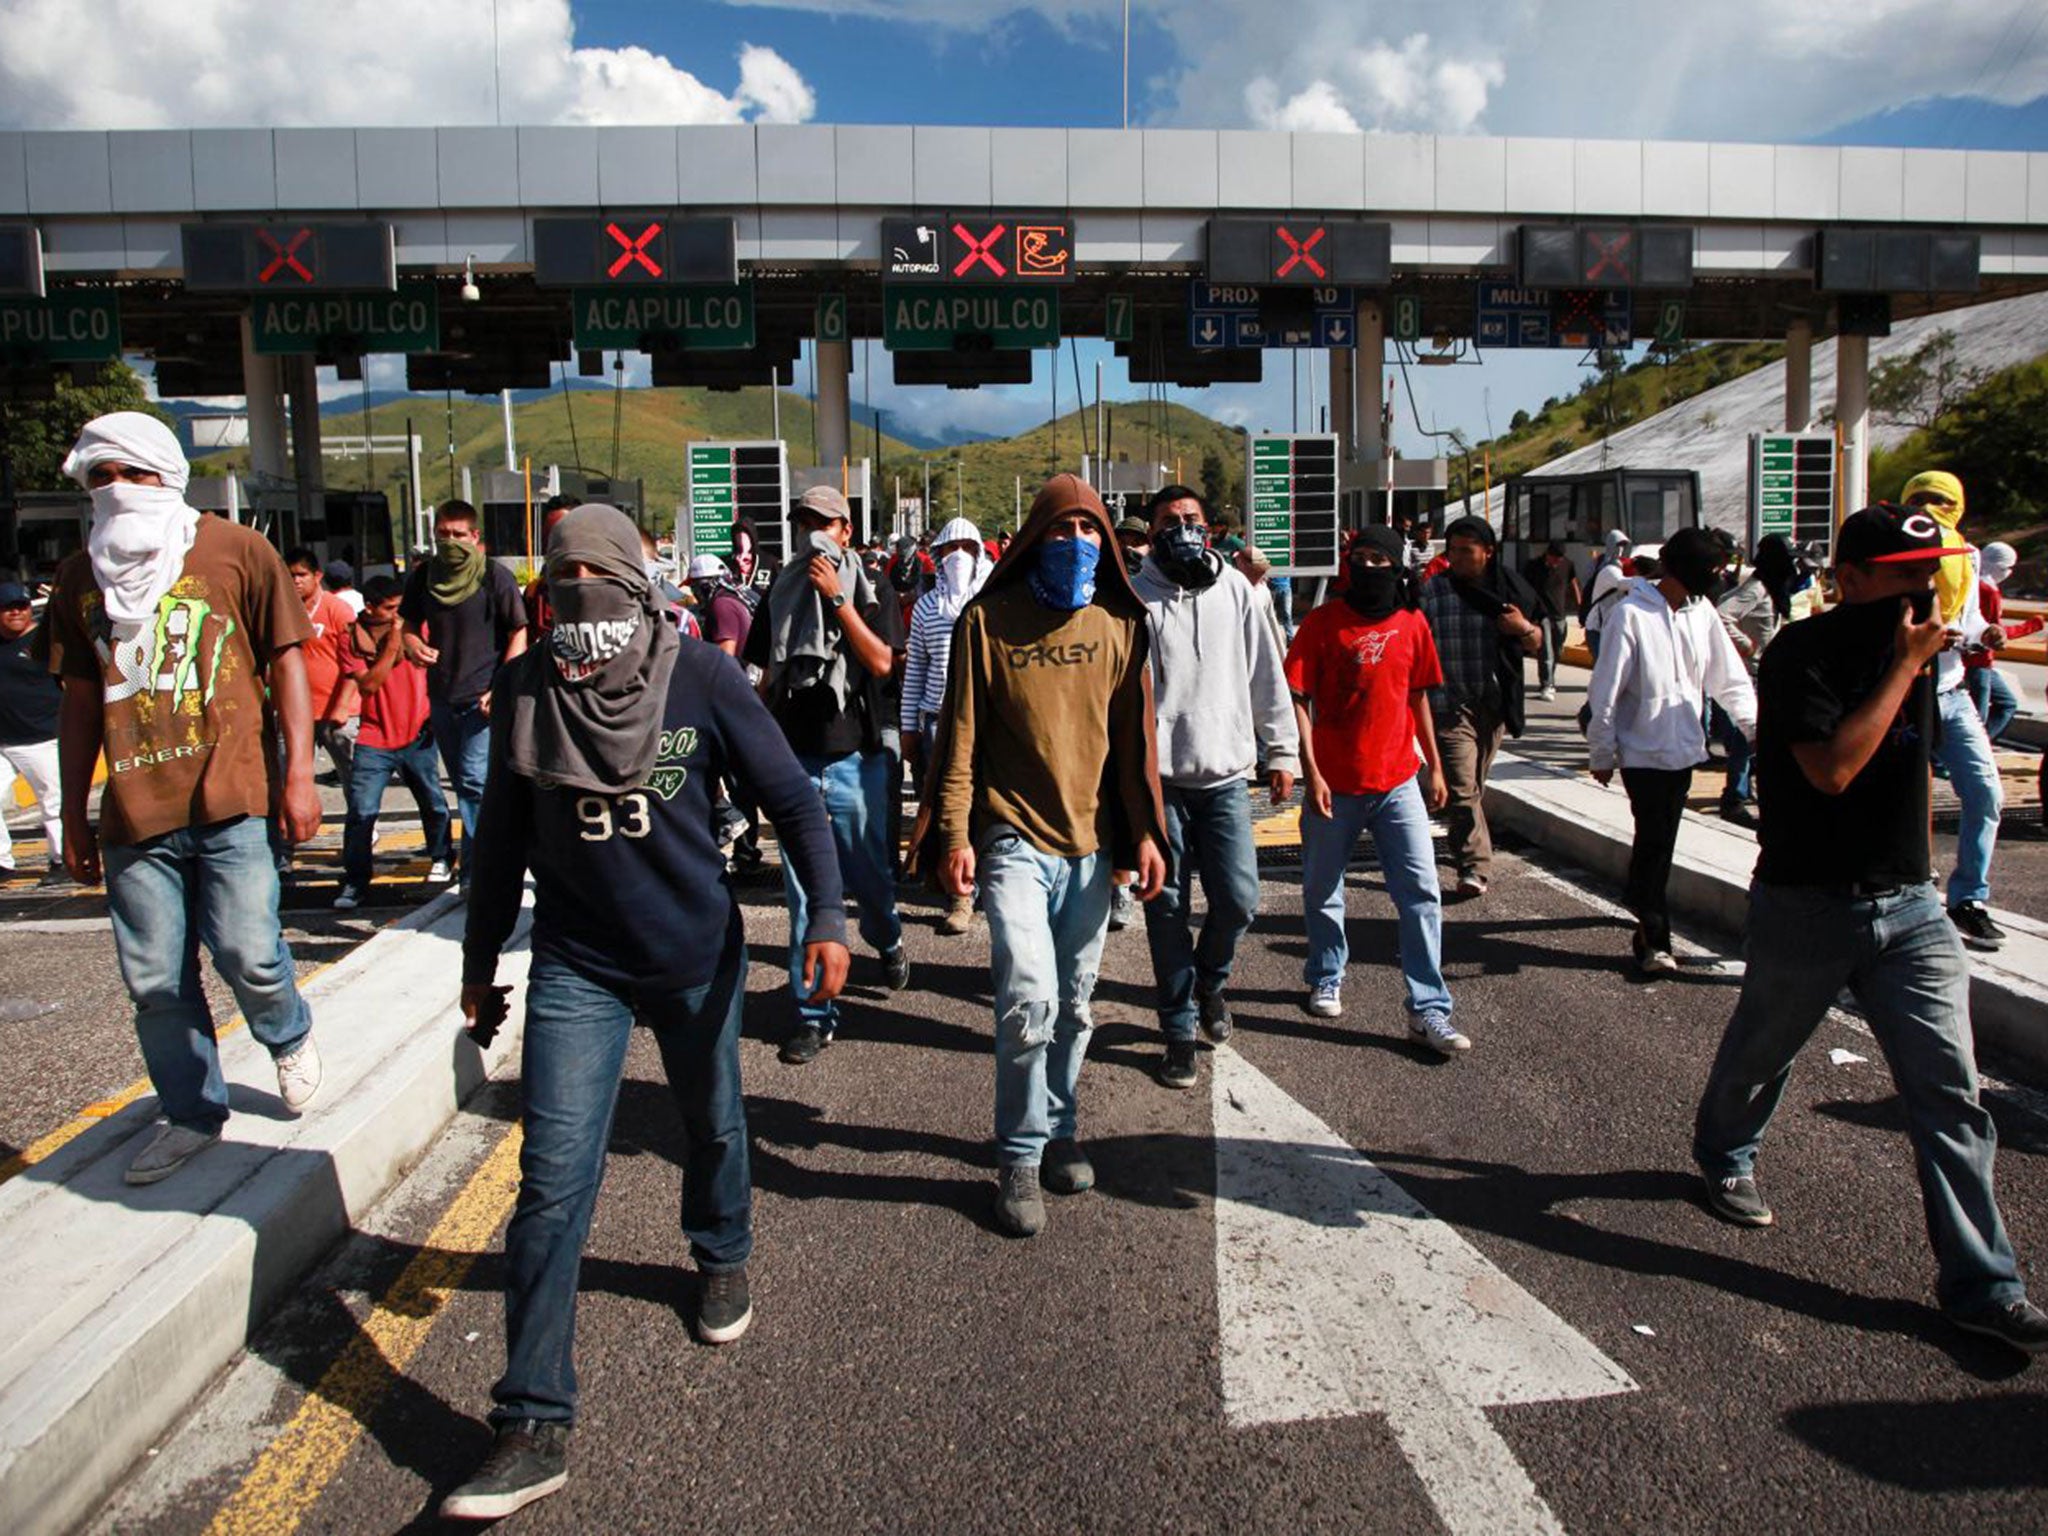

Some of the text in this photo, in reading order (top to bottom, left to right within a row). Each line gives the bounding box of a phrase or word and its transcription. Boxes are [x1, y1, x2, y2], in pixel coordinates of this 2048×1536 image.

[892, 263, 939, 273] AUTOPAGO
[1207, 285, 1338, 305] PROXAD
[0, 306, 110, 342] PULCO
[263, 300, 427, 335] ACAPULCO
[585, 297, 742, 331] ACAPULCO
[823, 300, 842, 335] 6
[894, 297, 1050, 330] ACAPULCO
[1111, 299, 1126, 335] 7
[1399, 299, 1414, 335] 8
[1663, 304, 1680, 340] 9
[1902, 515, 1936, 538] C
[1011, 641, 1098, 669] OAKLEY
[577, 793, 651, 841] 93
